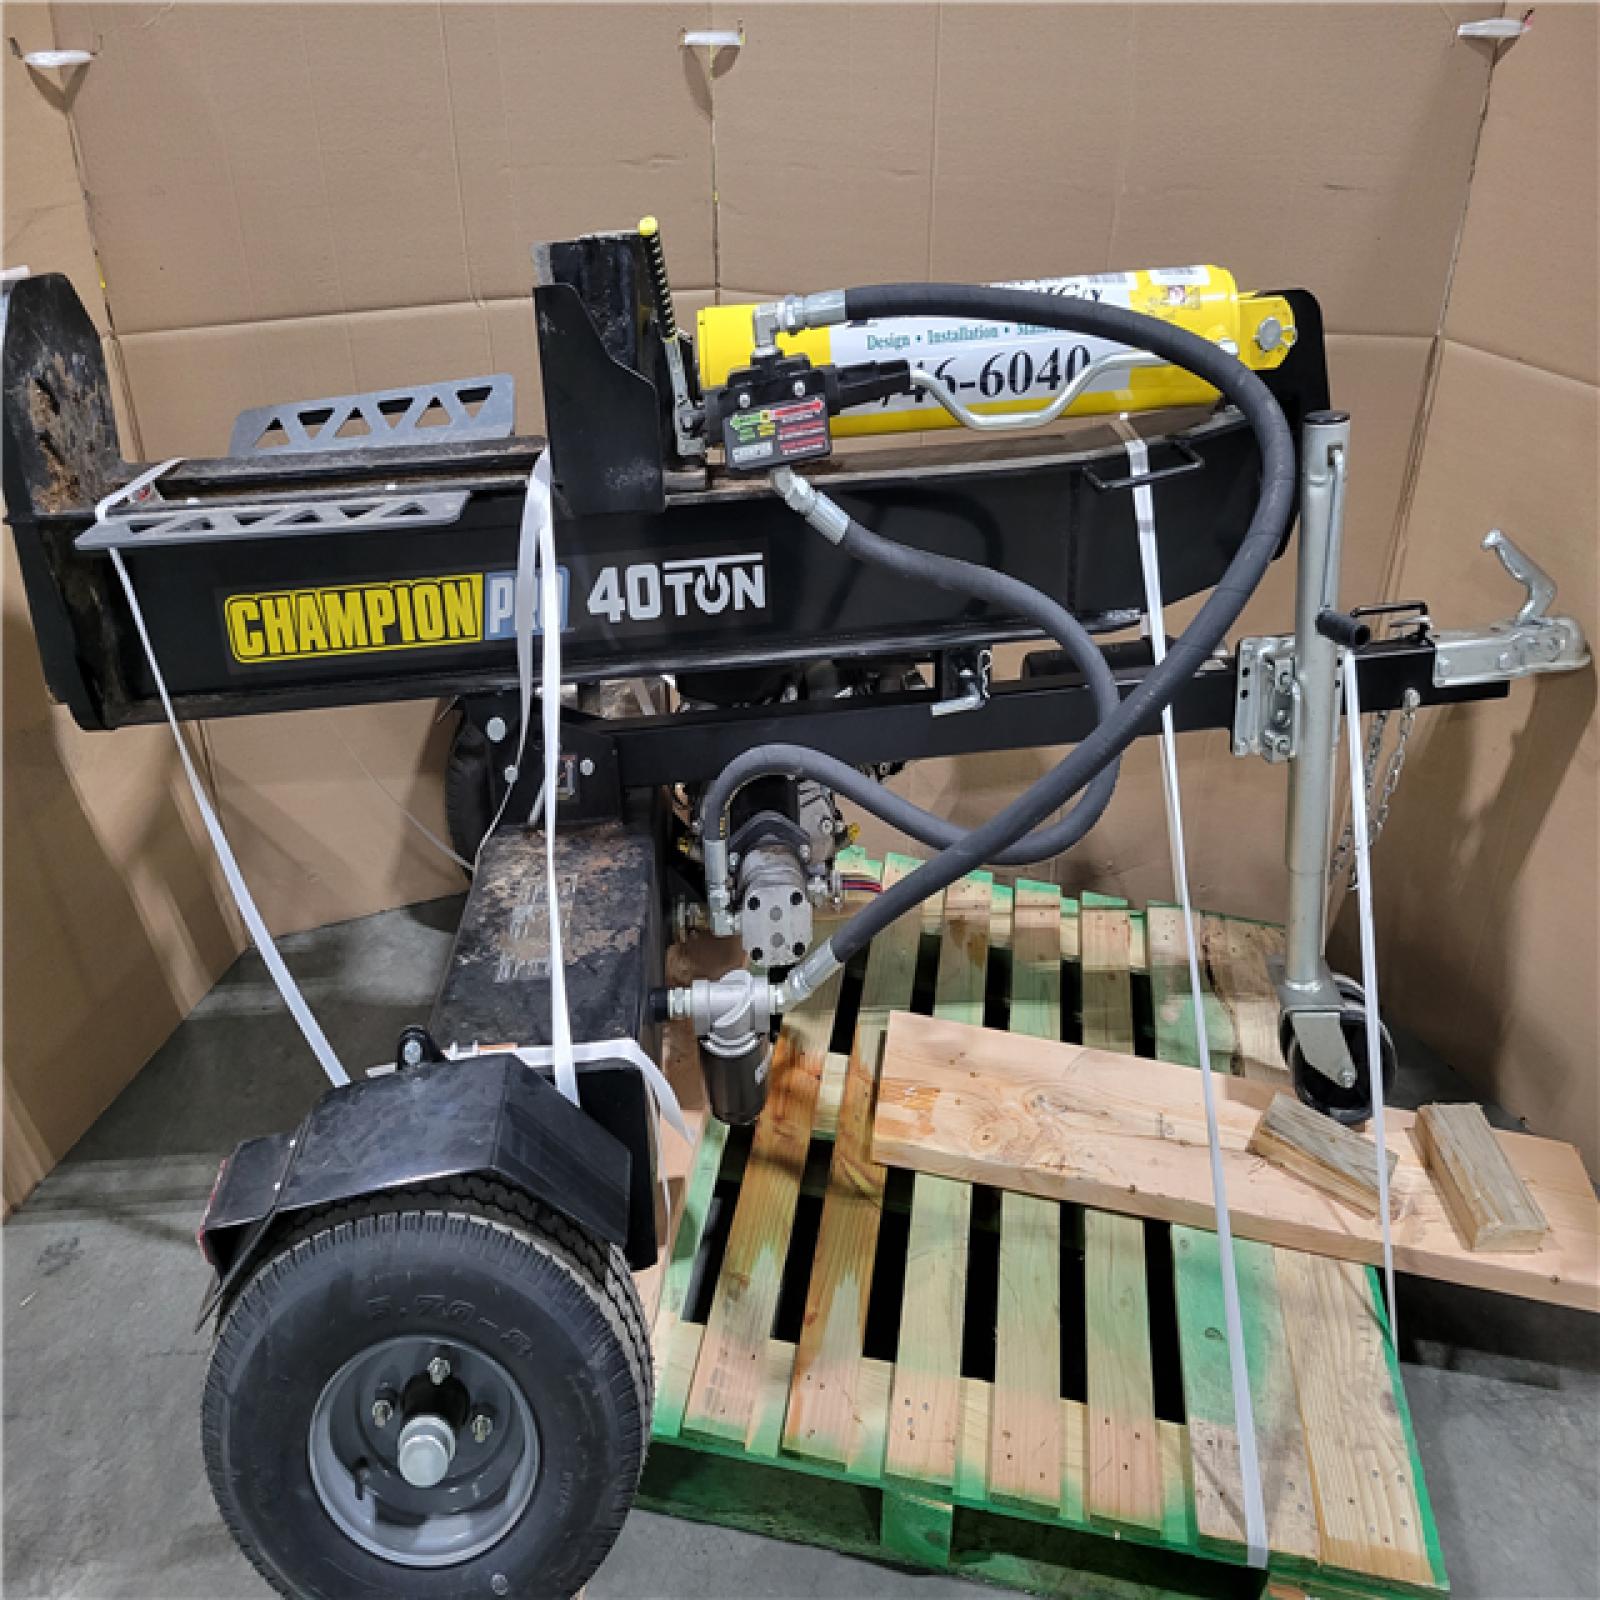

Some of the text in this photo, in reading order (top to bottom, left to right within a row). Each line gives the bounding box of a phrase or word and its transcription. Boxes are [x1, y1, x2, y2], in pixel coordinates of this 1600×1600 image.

[867, 332, 911, 350] Design
[927, 325, 999, 345] Installation
[229, 581, 477, 656] CHAMPION
